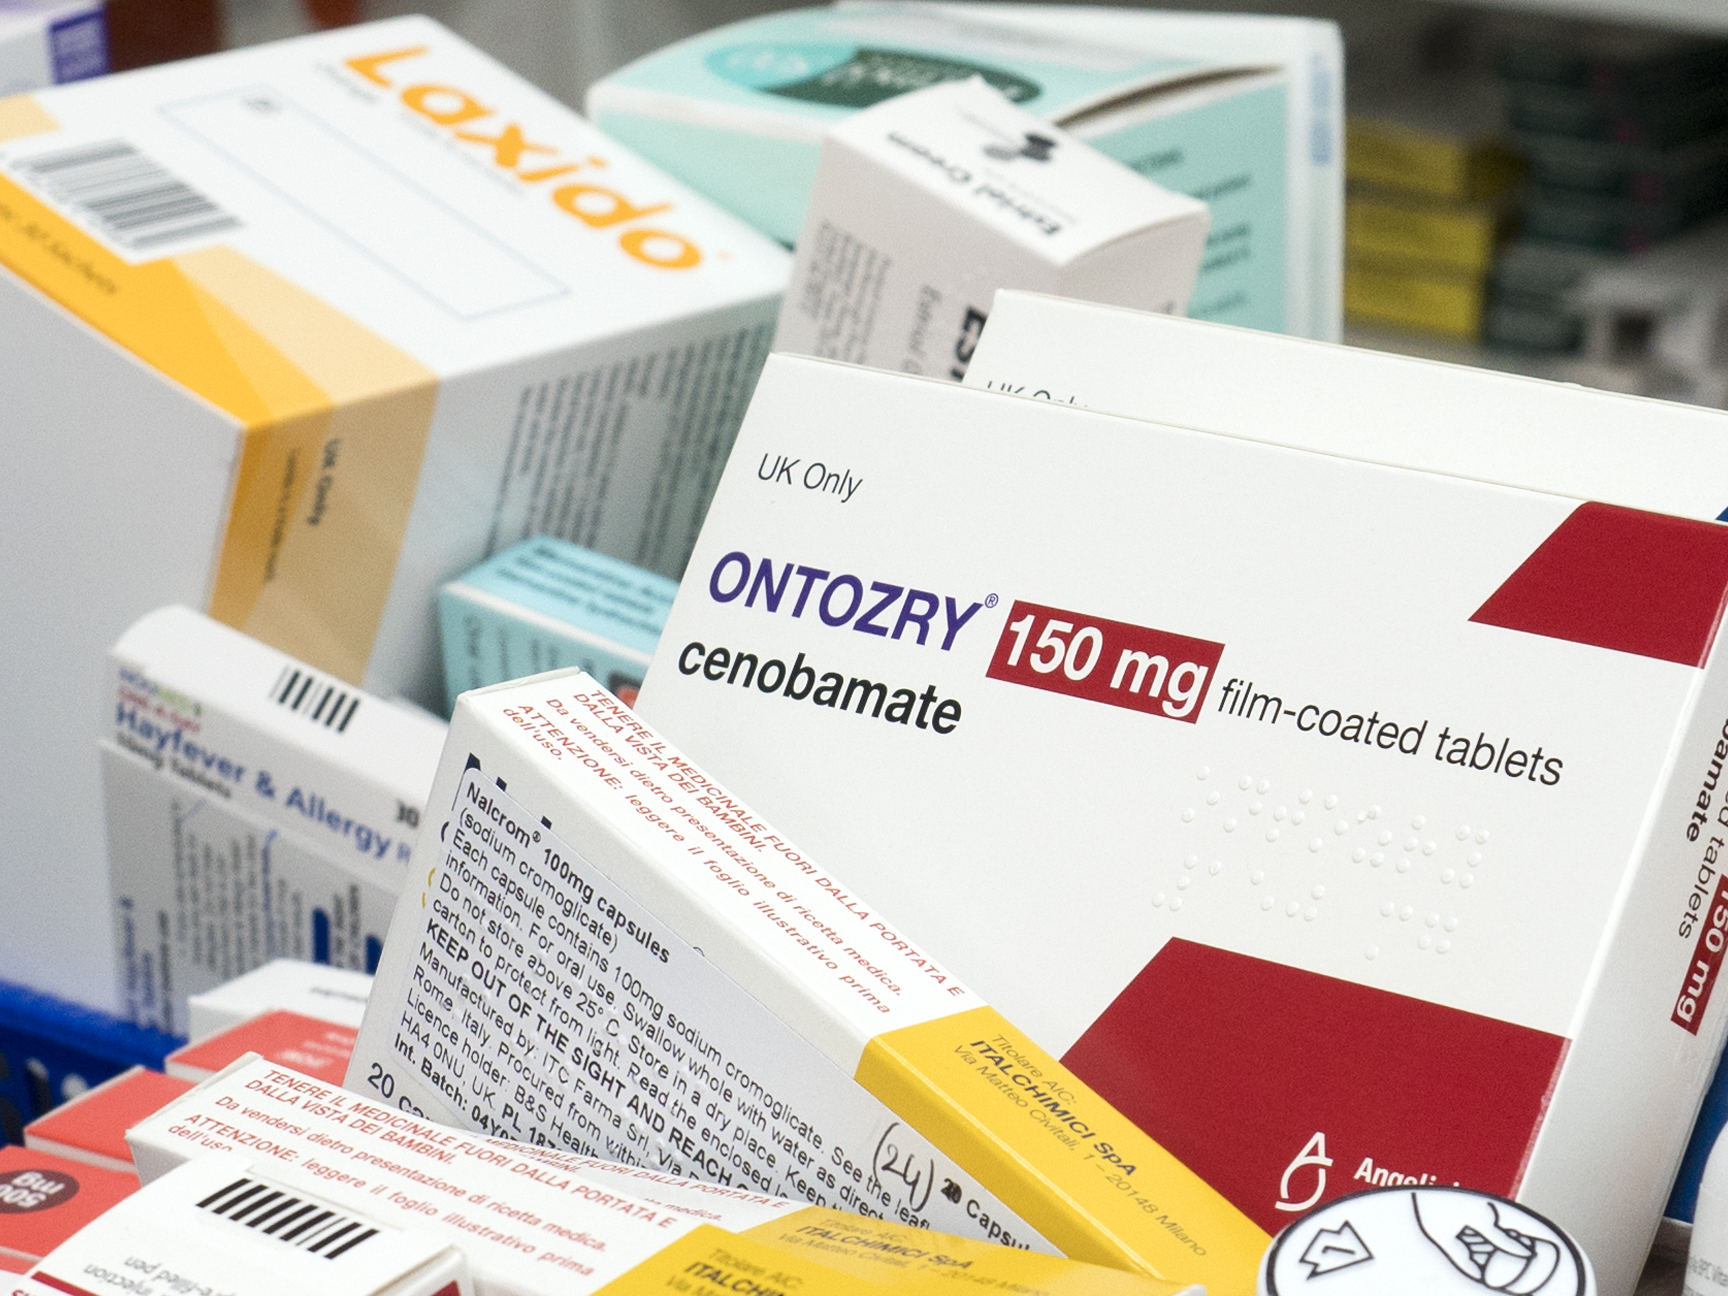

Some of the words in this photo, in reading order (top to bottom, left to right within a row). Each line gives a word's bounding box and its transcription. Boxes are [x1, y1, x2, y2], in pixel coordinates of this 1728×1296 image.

[341, 44, 703, 272] Laxido
[757, 452, 799, 490] UK
[802, 459, 863, 504] Only
[500, 706, 563, 762] dell'uso.
[677, 640, 963, 735] cenobamate
[1006, 613, 1099, 682] 150
[1117, 646, 1209, 720] mg
[1219, 679, 1427, 756] film-coated
[1434, 726, 1564, 788] tablets
[116, 703, 246, 784] Hayfever
[256, 770, 276, 799] &
[285, 786, 392, 860] Allergy
[543, 696, 570, 717] Da
[567, 716, 635, 769] vendersi
[627, 768, 675, 805] dietro
[667, 804, 777, 890] presentazione
[774, 889, 798, 904] di
[790, 903, 845, 946] ricetta
[841, 945, 902, 997] medica.
[571, 691, 626, 735] DALLA
[622, 732, 670, 773] VISTA
[665, 770, 701, 795] DEI
[694, 794, 768, 854] BAMBINI.
[588, 687, 655, 741] TENERE
[647, 739, 668, 756] IL
[665, 754, 768, 834] MEDICINALE
[761, 833, 819, 876] FUORI
[812, 875, 871, 922] DALLA
[866, 920, 948, 986] PORTATA
[944, 984, 966, 998] E
[457, 805, 517, 867] (sodium
[516, 859, 619, 955] cromoglicate)
[515, 703, 624, 791] ATTENZIONE:
[622, 792, 686, 843] leggere
[685, 844, 706, 857] il
[701, 858, 751, 898] foglio
[750, 898, 839, 971] illustrativo
[836, 973, 891, 1015] prima
[542, 846, 595, 906] 100mg
[595, 894, 671, 965] capsules
[1678, 838, 1725, 940] tablets
[424, 916, 471, 964] KEEP
[469, 958, 508, 999] OUT
[506, 991, 534, 1020] OF
[534, 1011, 571, 1056] THE
[569, 1045, 628, 1100] SIGHT
[624, 1092, 667, 1135] AND
[666, 1125, 734, 1188] REACH
[450, 826, 490, 872] Each
[488, 864, 546, 921] capsule
[546, 913, 610, 975] contains
[612, 964, 665, 1023] 100mg
[664, 1011, 723, 1068] sodium
[723, 1060, 824, 1151] cromoglicate.
[829, 1144, 864, 1185] See
[864, 1173, 894, 1212] the
[1676, 961, 1710, 1023] mg
[11, 1170, 65, 1195] mg
[968, 1038, 1097, 1140] ITALCHIMICI
[1091, 1140, 1138, 1178] SpA
